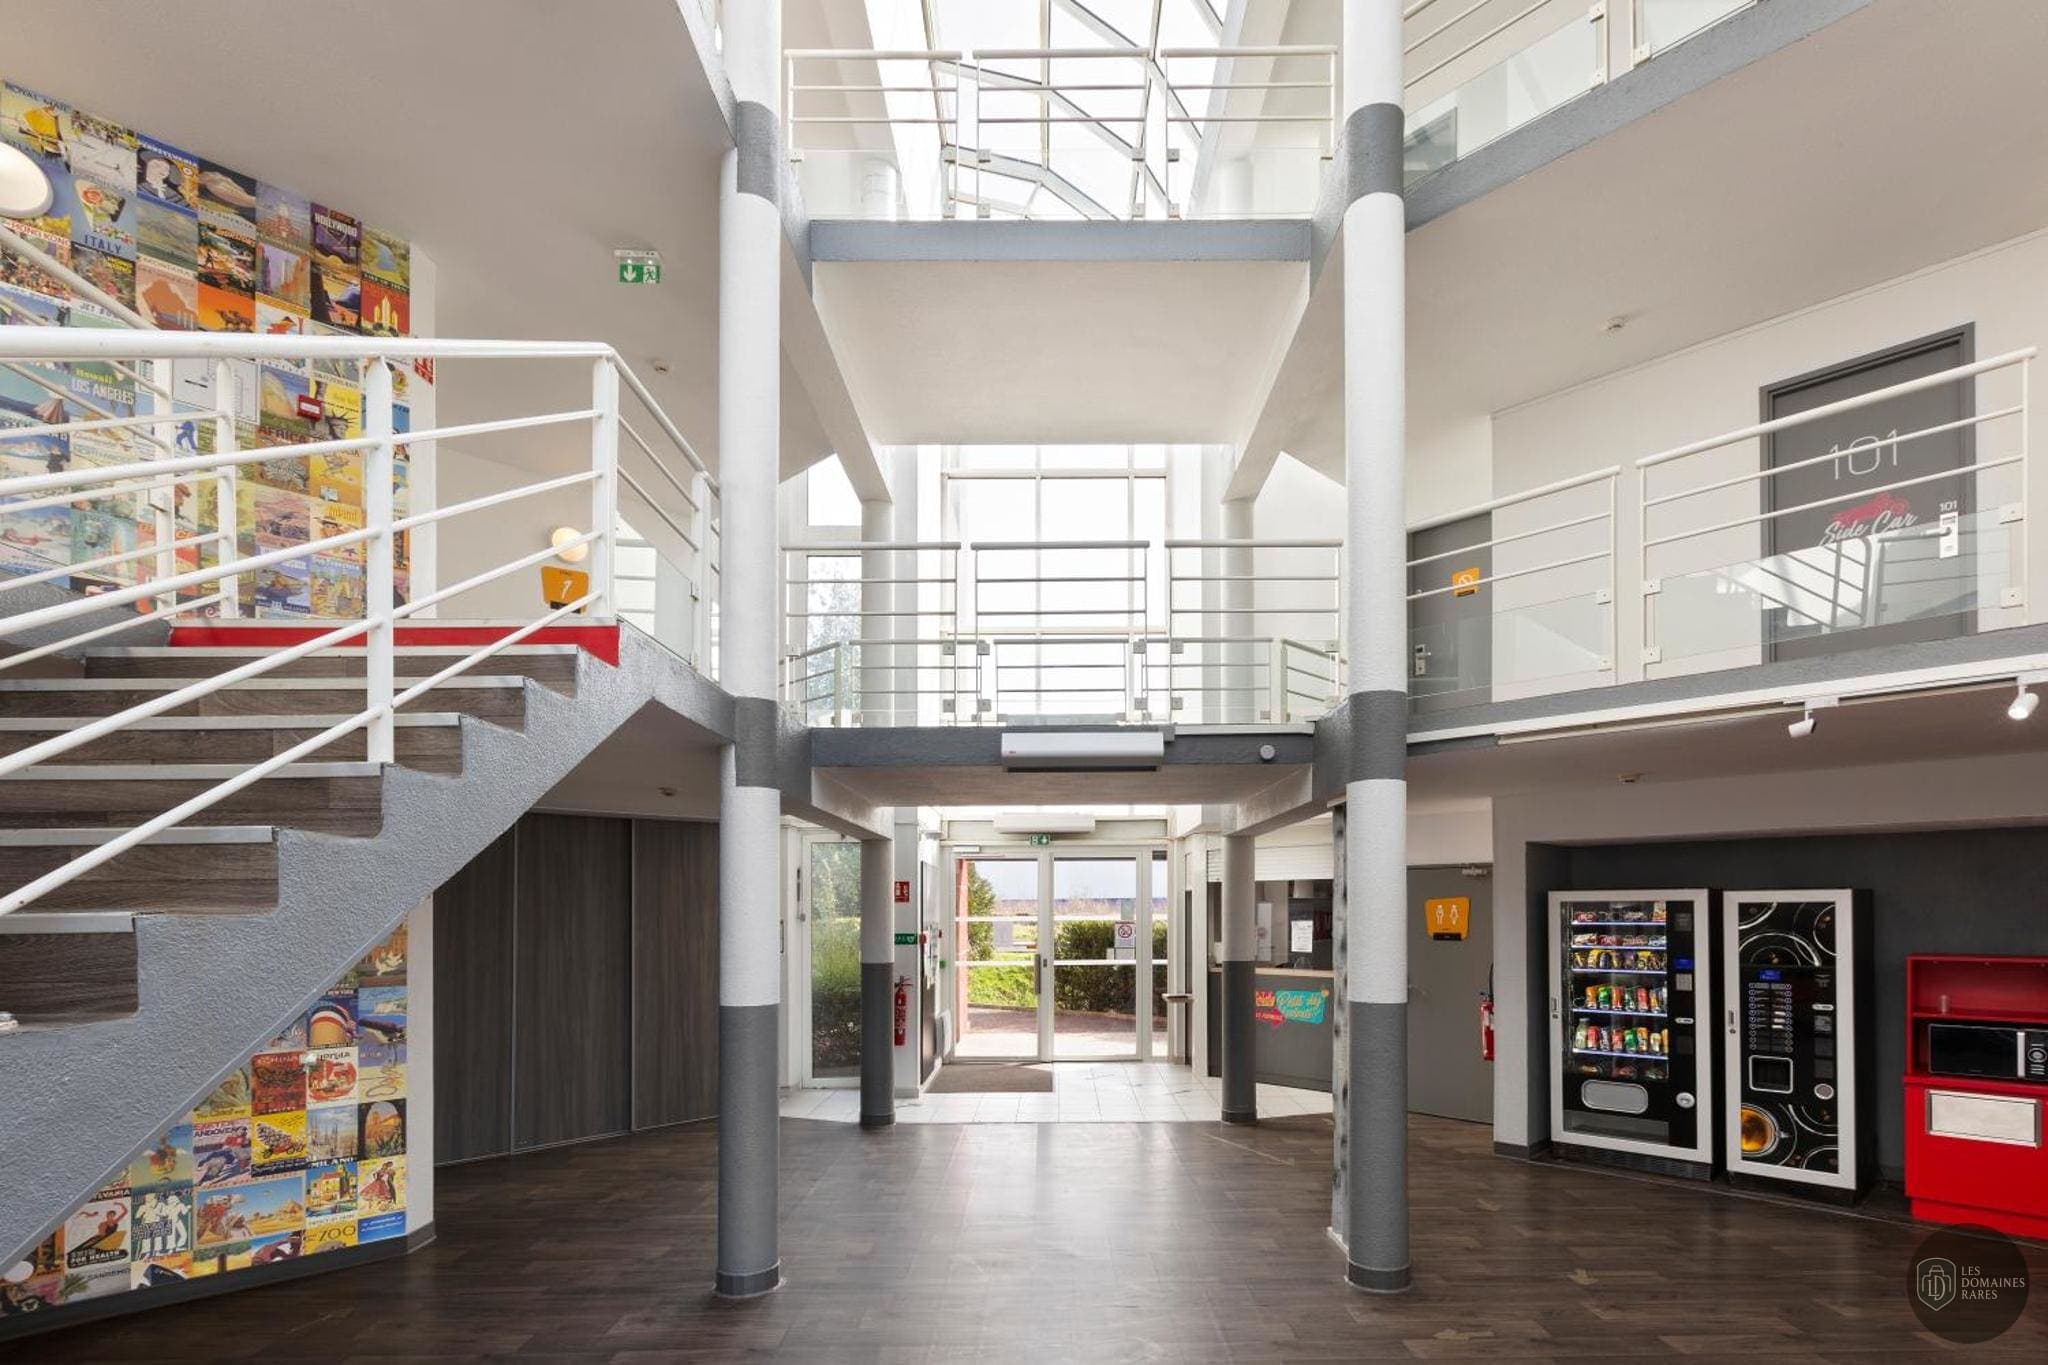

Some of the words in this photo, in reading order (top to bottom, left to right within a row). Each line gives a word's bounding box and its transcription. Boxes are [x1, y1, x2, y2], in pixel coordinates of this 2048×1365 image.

[314, 212, 358, 238] HOLLYWOOD
[84, 233, 123, 255] ITALY
[71, 378, 90, 394] LOS
[92, 382, 135, 406] ANGELES
[257, 425, 307, 443] AFRICA
[1829, 428, 1899, 480] 101
[1939, 500, 1958, 512] 101
[1818, 520, 1870, 548] Side
[1871, 510, 1919, 536] Car
